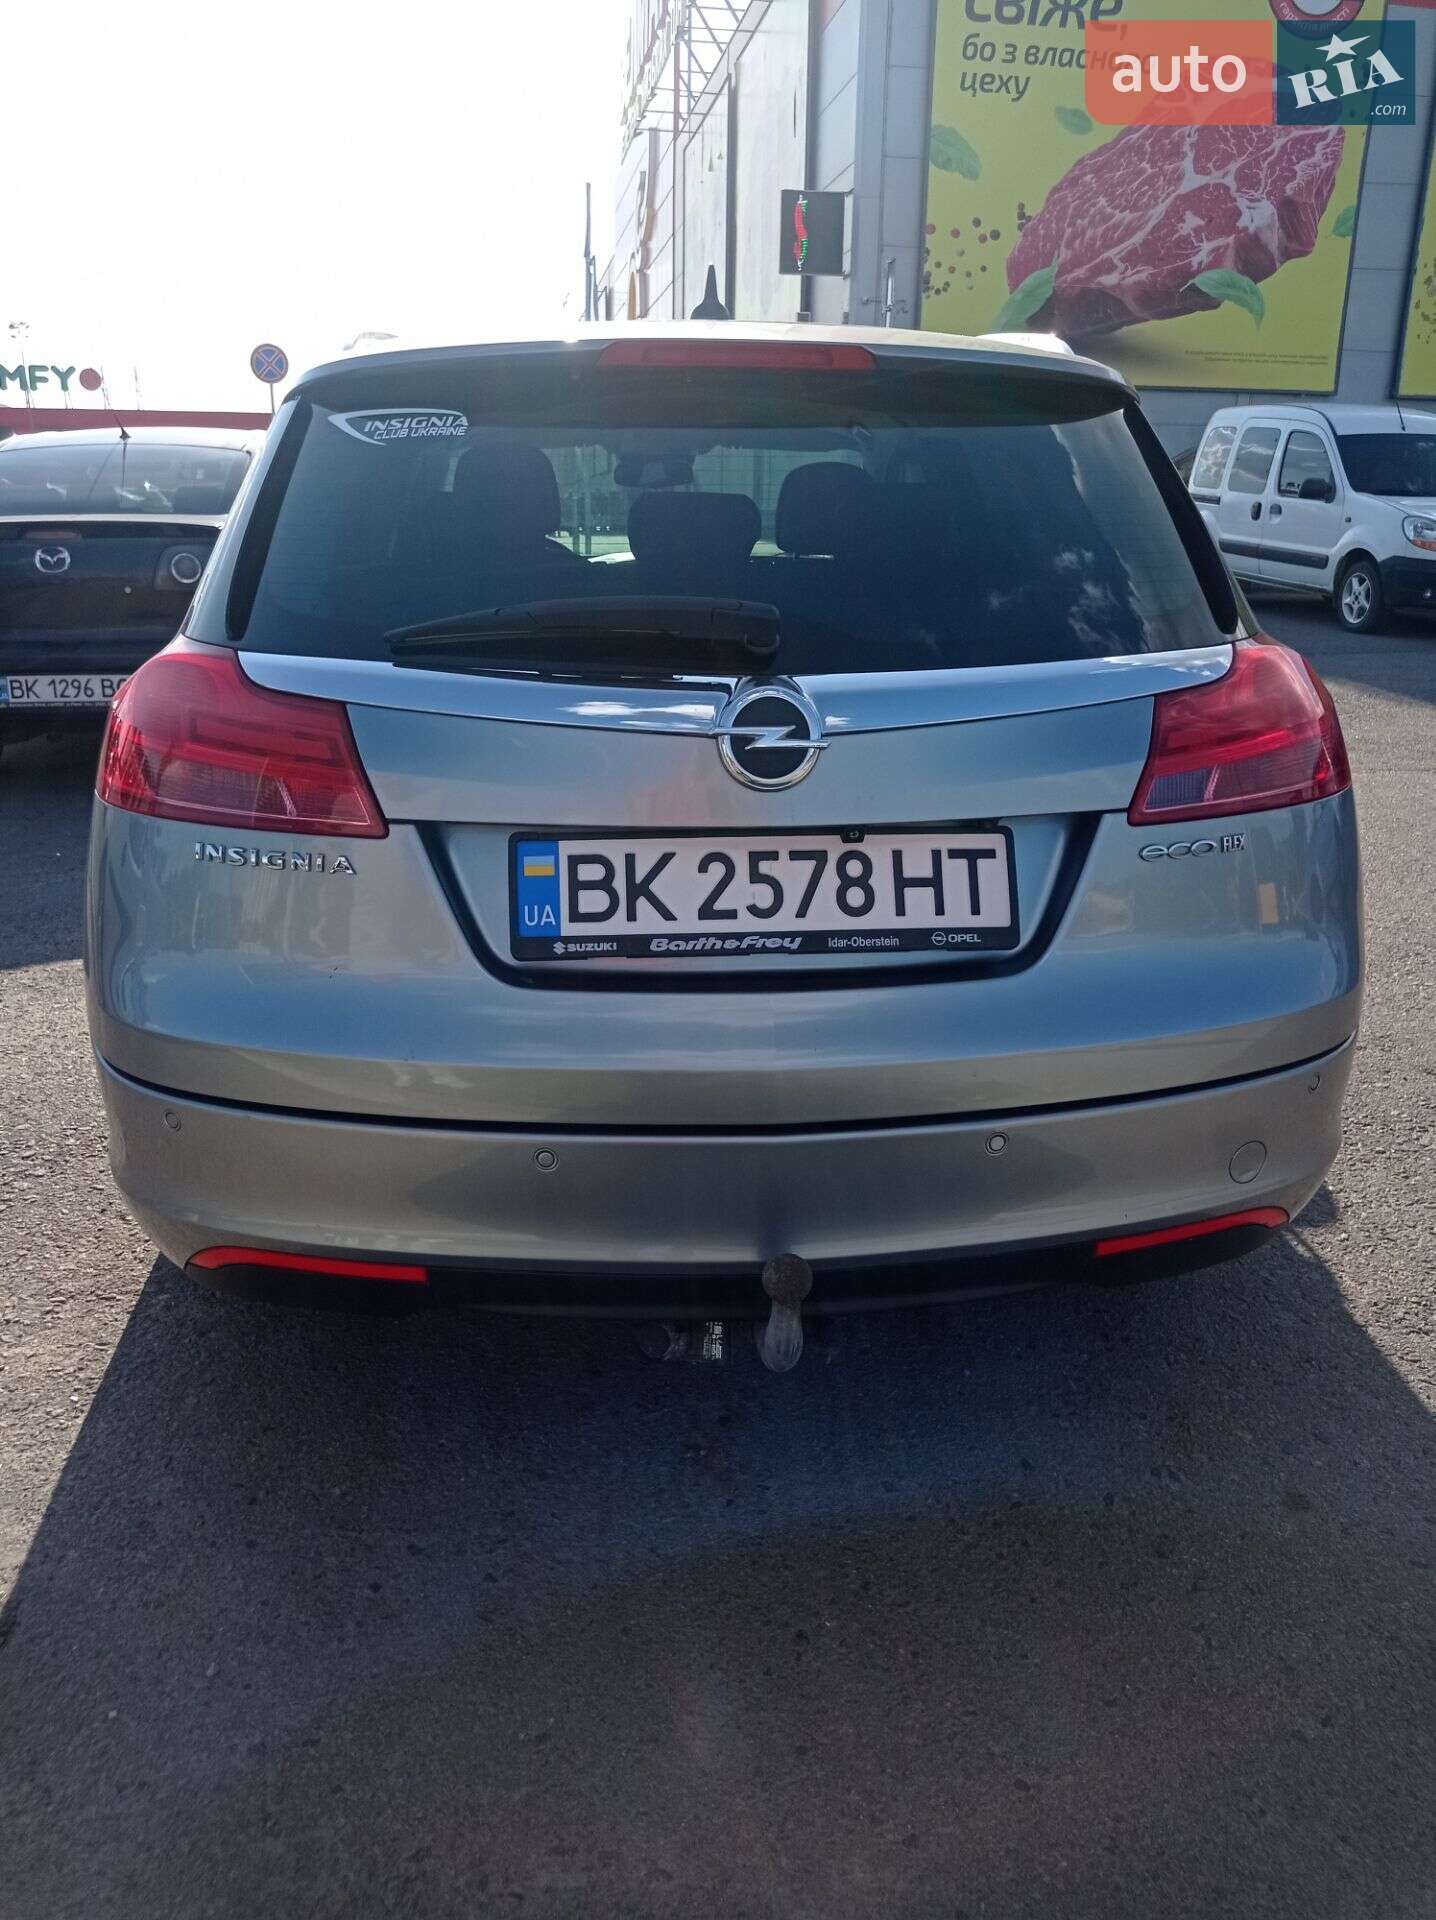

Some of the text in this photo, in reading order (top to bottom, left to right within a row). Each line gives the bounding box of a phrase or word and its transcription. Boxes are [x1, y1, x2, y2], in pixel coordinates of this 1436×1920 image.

[962, 33, 996, 62] бо
[1002, 43, 1018, 63] з
[960, 71, 1031, 102] цеху
[364, 415, 469, 432] INSIGNIA
[374, 426, 468, 440] CLUB UKRAINE
[9, 679, 40, 699] BK
[48, 679, 95, 698] 1296
[194, 841, 357, 876] INSIGNIA
[567, 848, 997, 923] BK 2578 HT
[524, 905, 556, 927] UA
[567, 942, 617, 952] SUZUKI
[828, 936, 900, 948] Idar-Oberstein
[948, 933, 982, 943] OPEL
